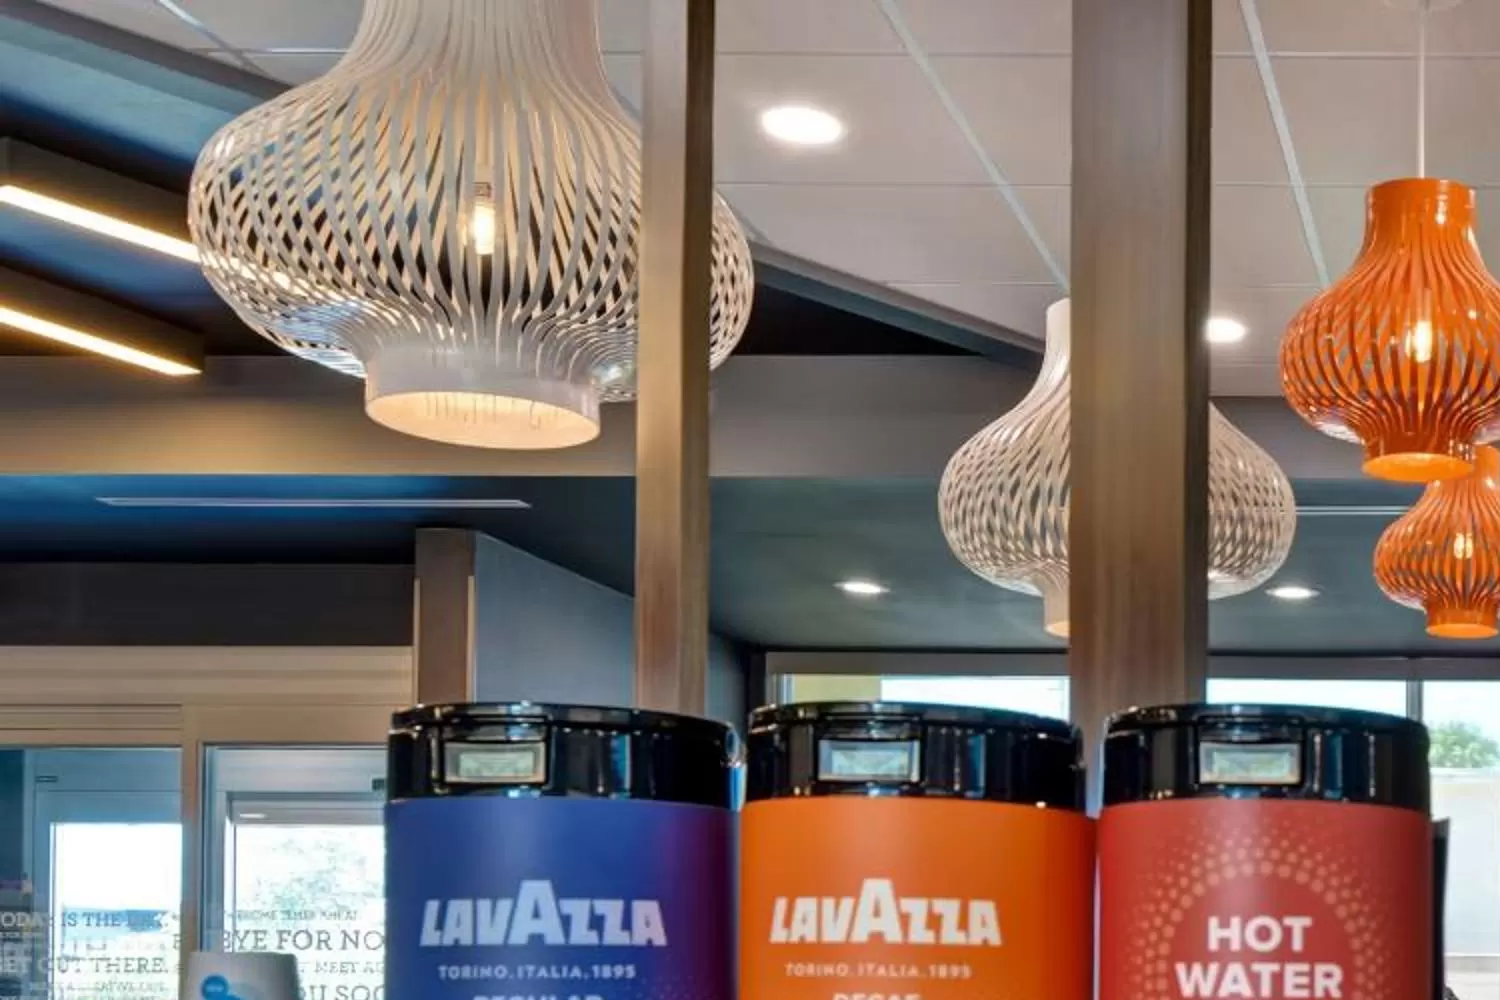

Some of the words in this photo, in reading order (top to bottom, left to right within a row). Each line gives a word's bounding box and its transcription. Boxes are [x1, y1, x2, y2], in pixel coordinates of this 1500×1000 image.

[0, 911, 53, 928] ODA
[82, 911, 121, 928] THE
[420, 879, 668, 948] LAVAZZA
[768, 877, 1003, 947] LAVAZZA
[276, 928, 333, 951] FOR
[340, 929, 386, 951] NO
[1207, 916, 1313, 952] HOT
[92, 957, 169, 974] THERE.
[1174, 962, 1344, 1000] WATER
